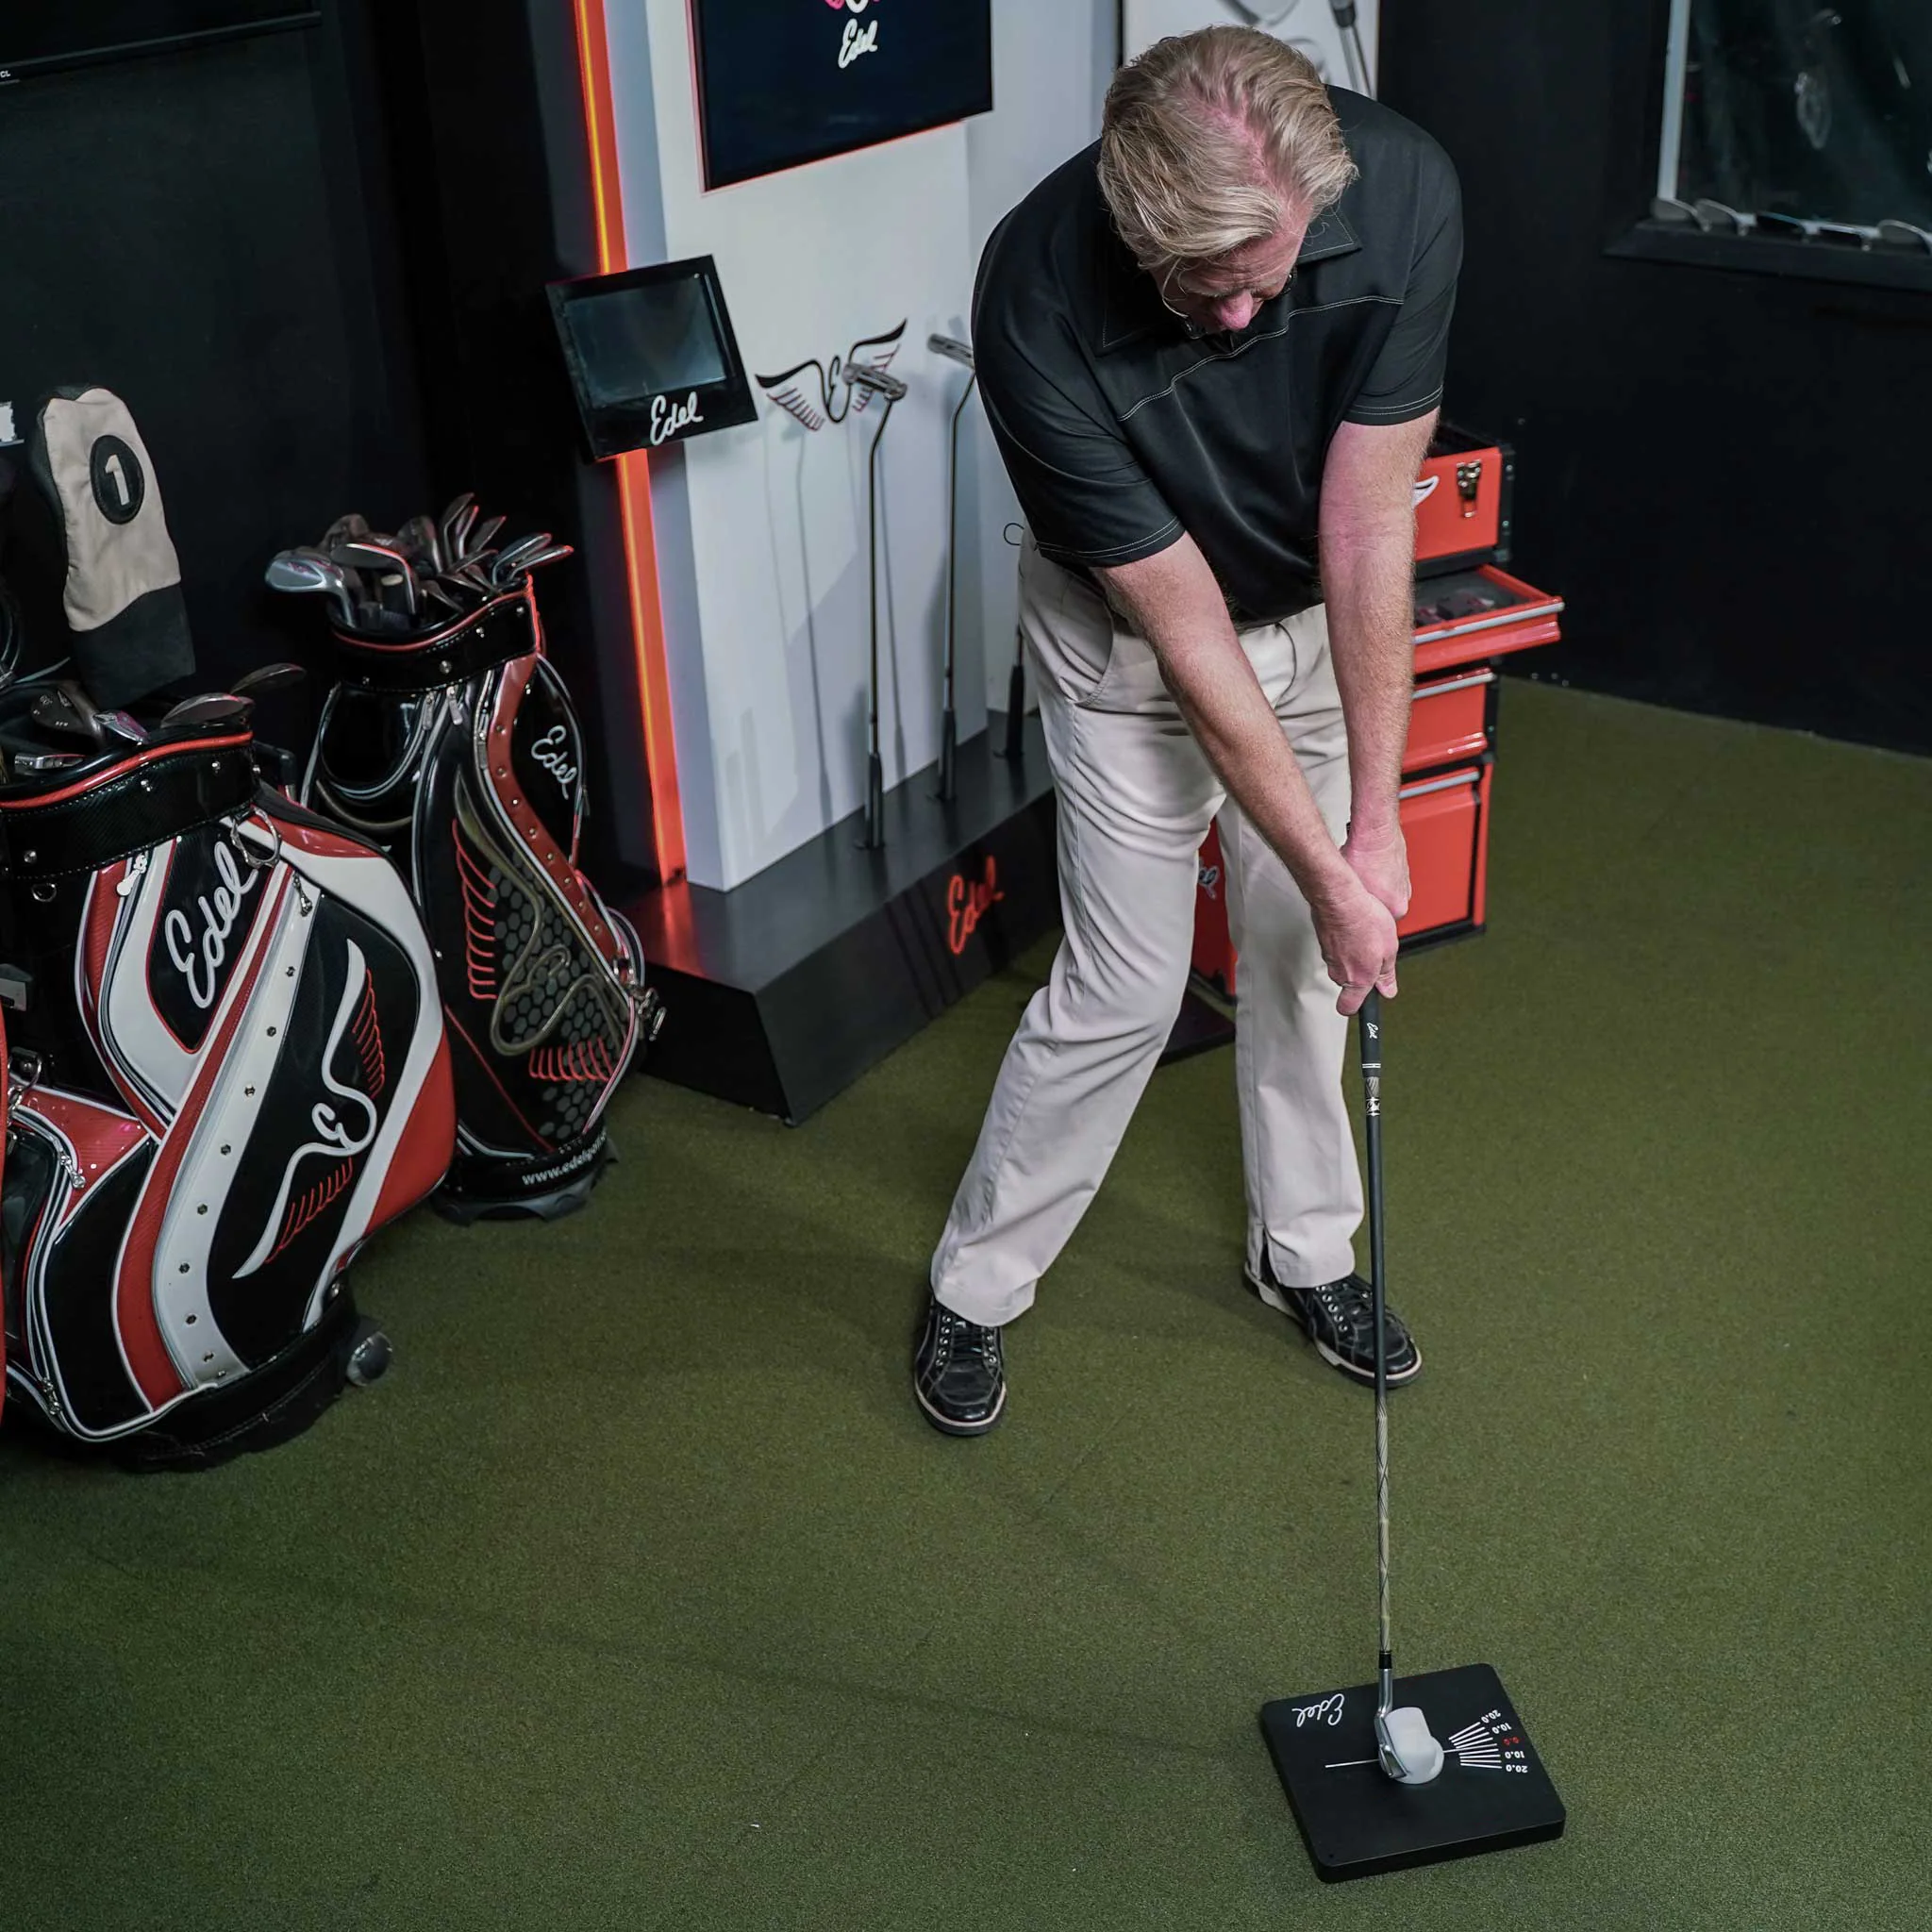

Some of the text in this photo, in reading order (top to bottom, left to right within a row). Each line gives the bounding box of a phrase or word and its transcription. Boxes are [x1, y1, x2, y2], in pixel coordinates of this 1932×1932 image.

[838, 18, 878, 69] Edel
[650, 391, 704, 446] Edel
[105, 454, 130, 506] 1
[531, 724, 577, 800] Edel
[164, 841, 259, 1009] Edel
[947, 855, 1005, 955] Edel
[1291, 1692, 1345, 1727] Edel
[1480, 1709, 1502, 1724] 20.0
[1491, 1722, 1512, 1734] 10.0
[1504, 1750, 1525, 1759] 10.0
[1505, 1764, 1528, 1774] 20.0
